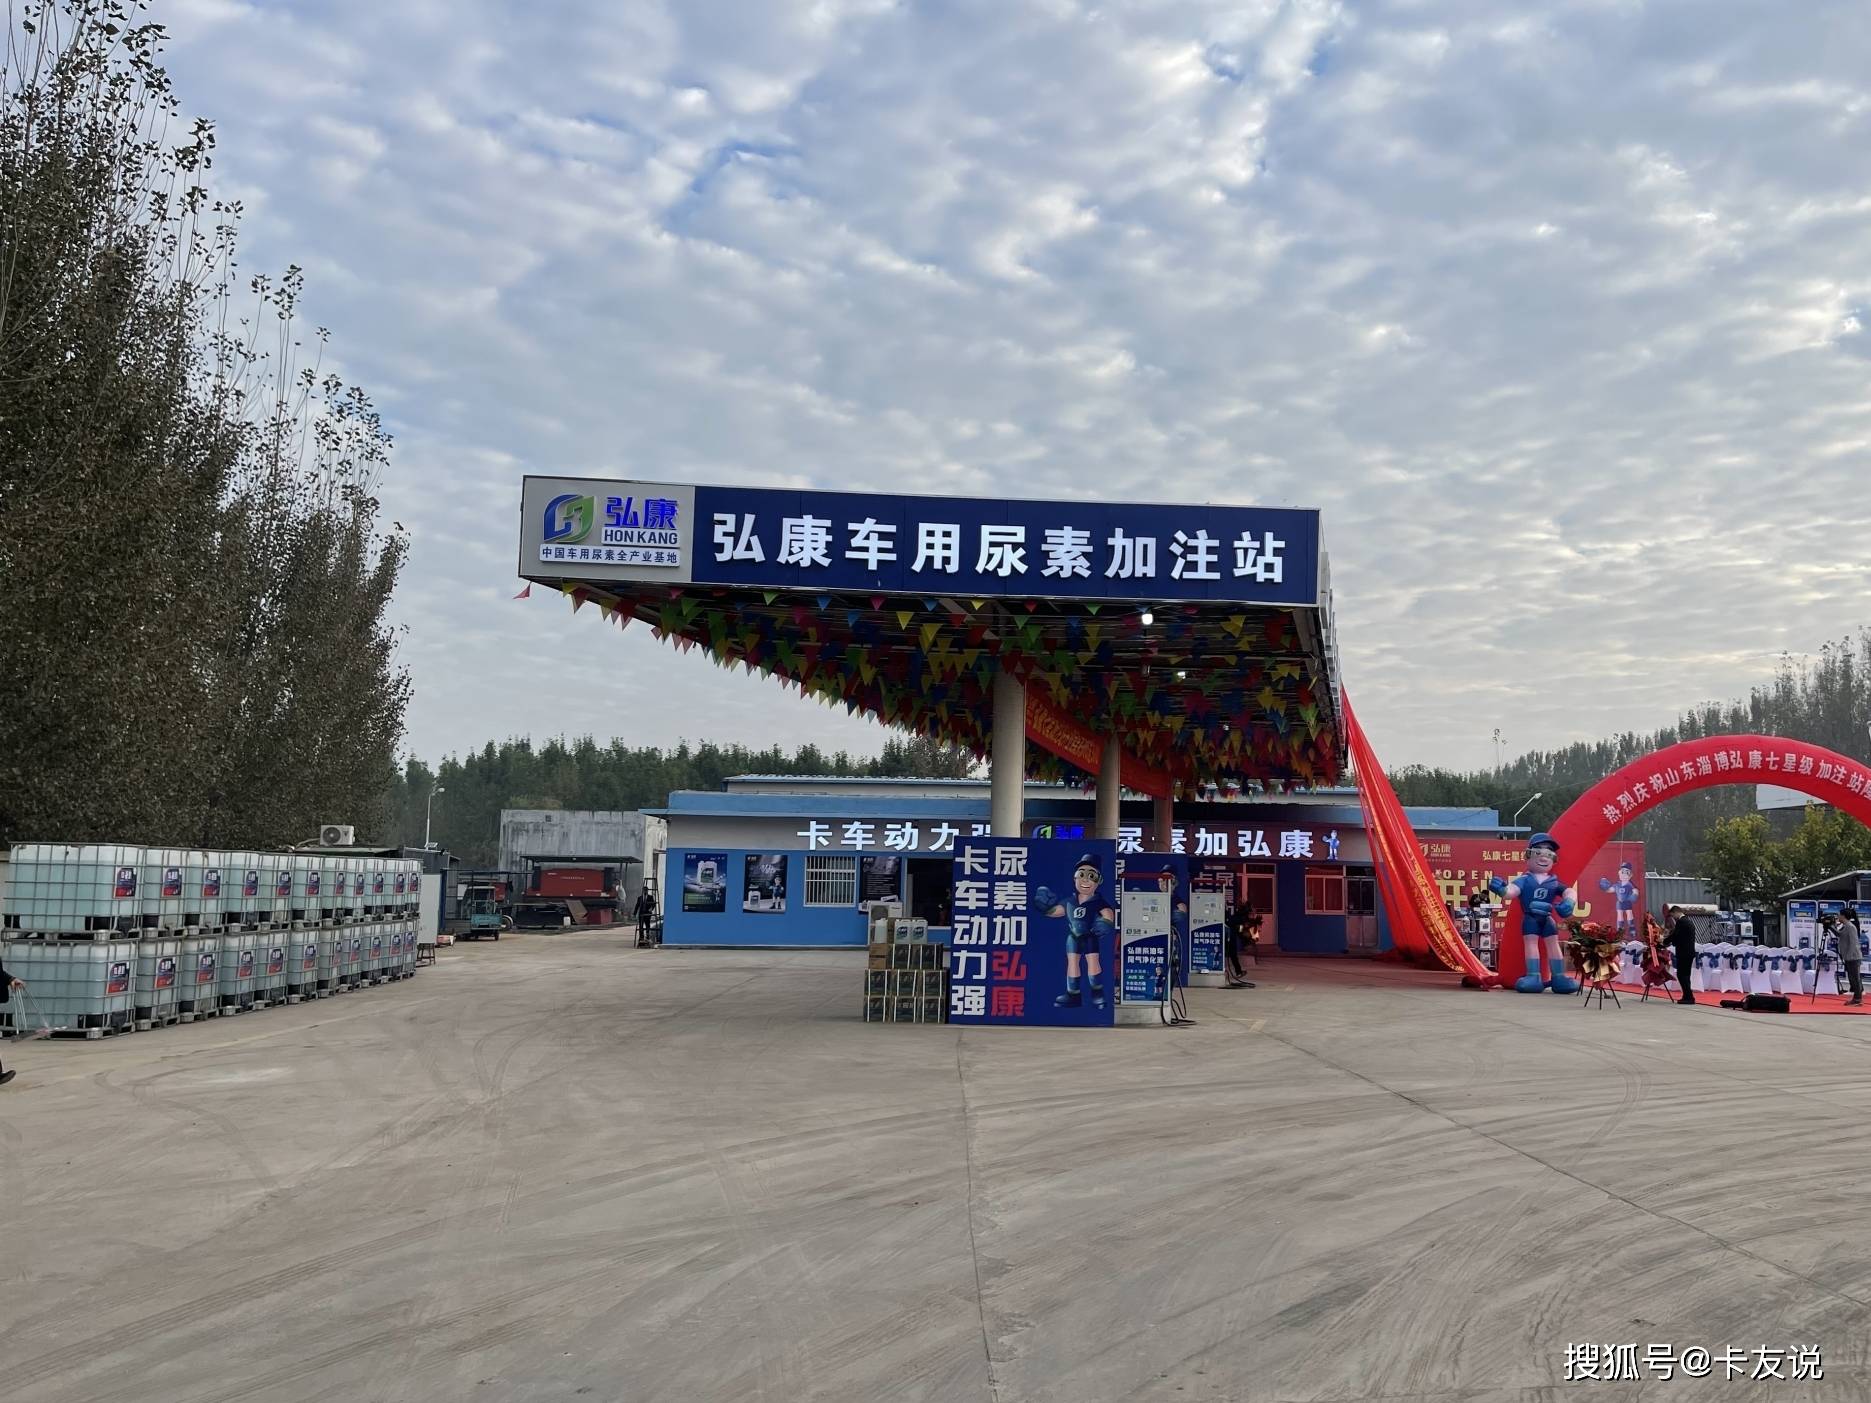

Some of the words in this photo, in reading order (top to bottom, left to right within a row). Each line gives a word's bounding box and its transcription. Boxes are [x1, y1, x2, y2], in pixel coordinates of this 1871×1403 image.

[605, 496, 679, 530] 弘康
[604, 529, 634, 542] HON
[637, 533, 678, 544] KANG
[712, 511, 1286, 584] 弘康车用尿素加注站
[542, 546, 678, 564] 中国车用尿素全产业基地
[797, 820, 991, 851] 卡车动力
[951, 846, 989, 1016] 卡车动力强
[990, 846, 1028, 1017] 尿素加弘康
